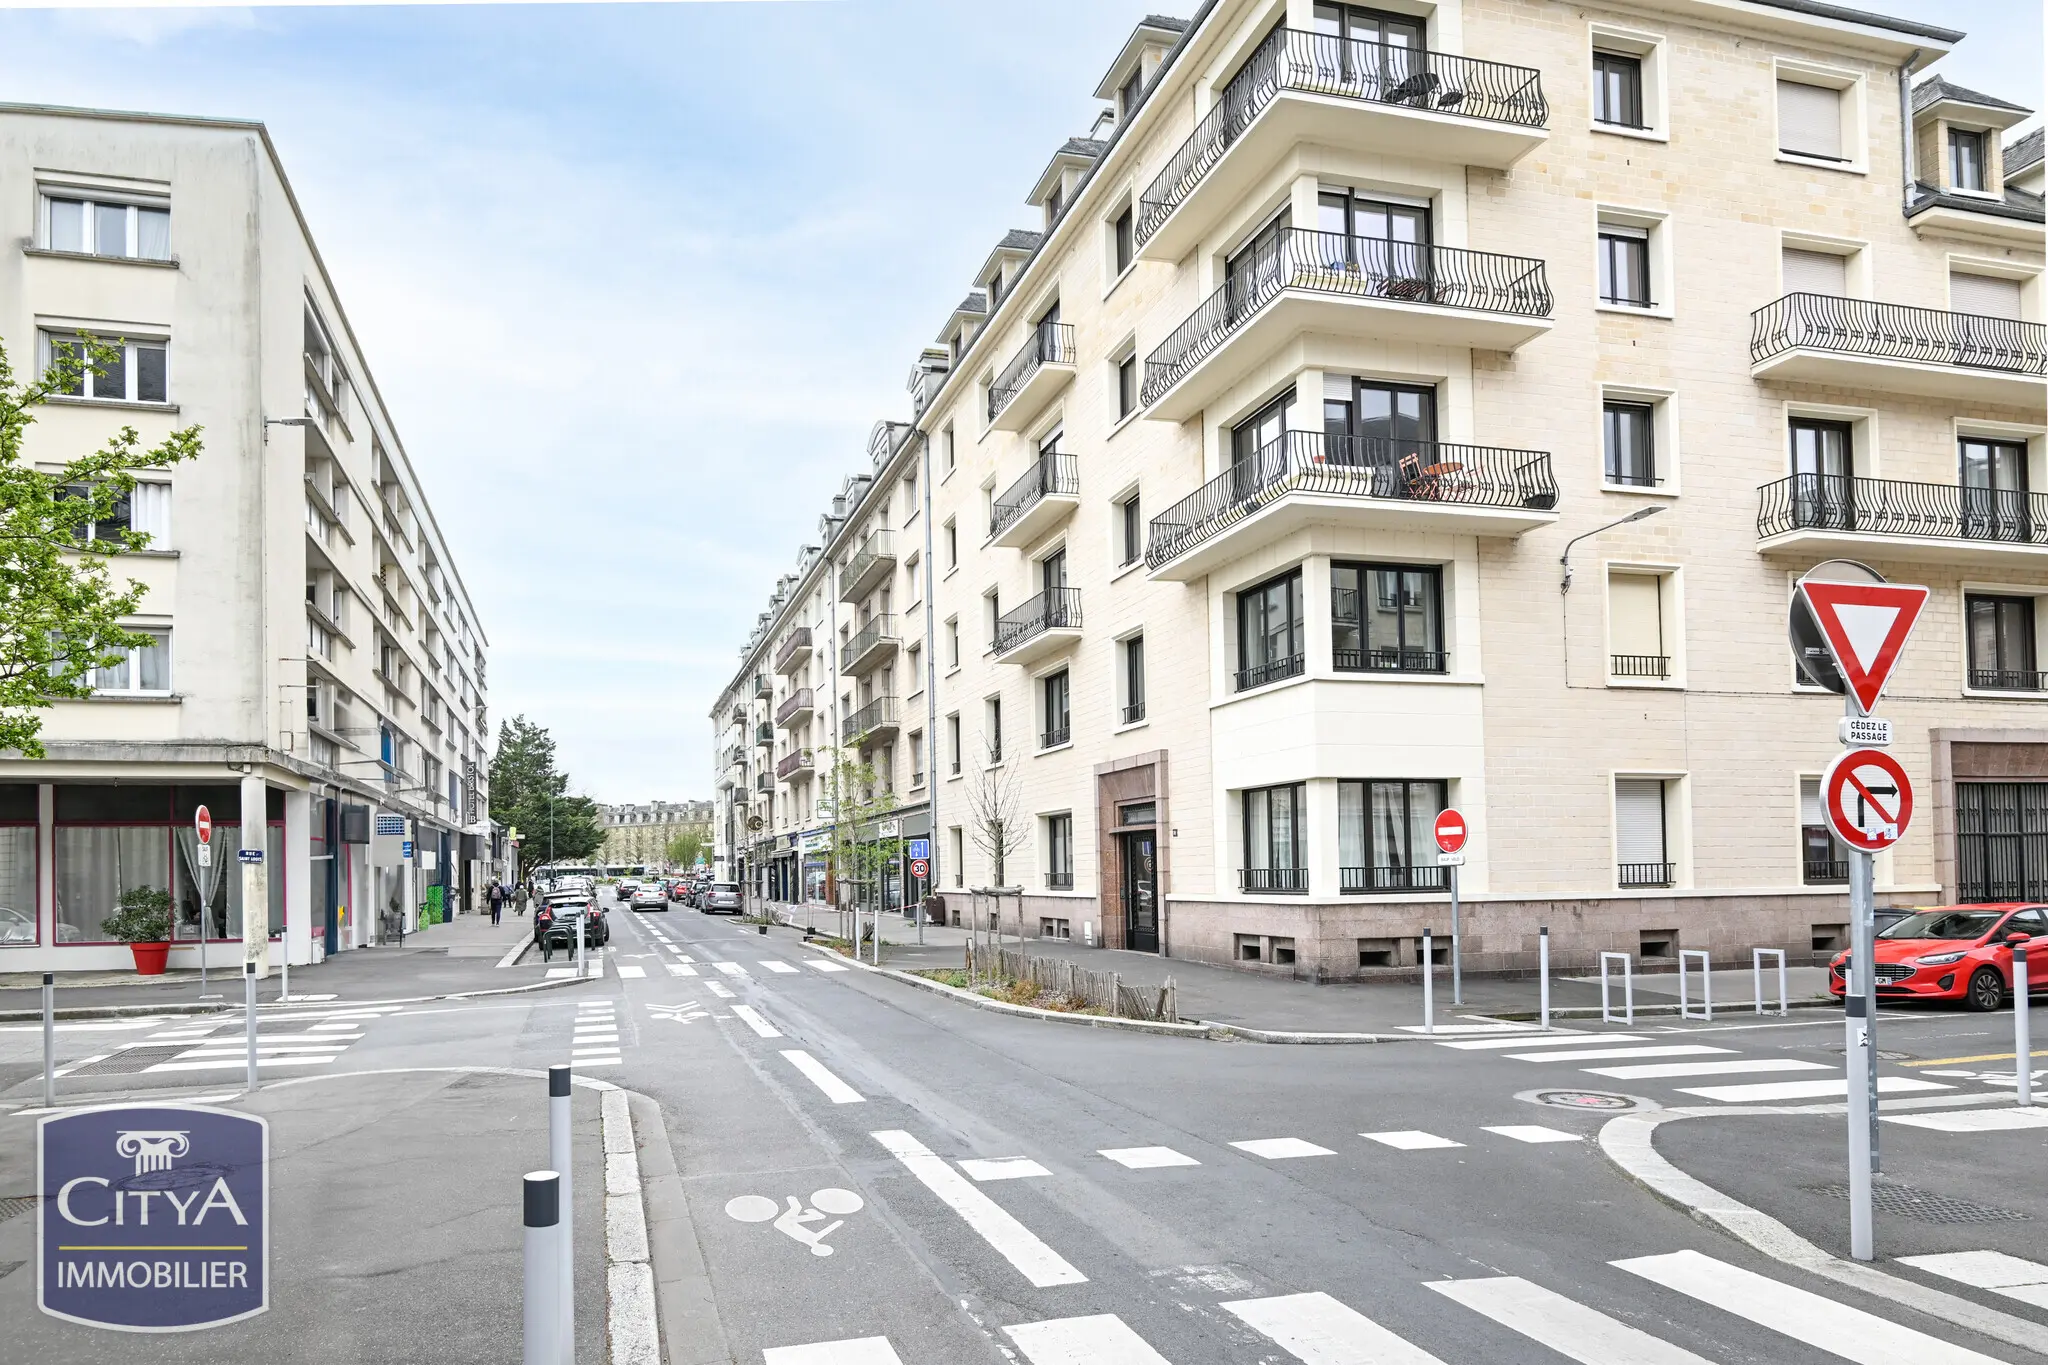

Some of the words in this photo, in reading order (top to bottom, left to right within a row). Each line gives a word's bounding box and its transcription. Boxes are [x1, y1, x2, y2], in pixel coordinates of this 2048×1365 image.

[1850, 720, 1876, 731] CÉDEZ
[1877, 722, 1888, 731] LE
[1850, 732, 1888, 742] PASSAGE
[914, 864, 925, 873] 30
